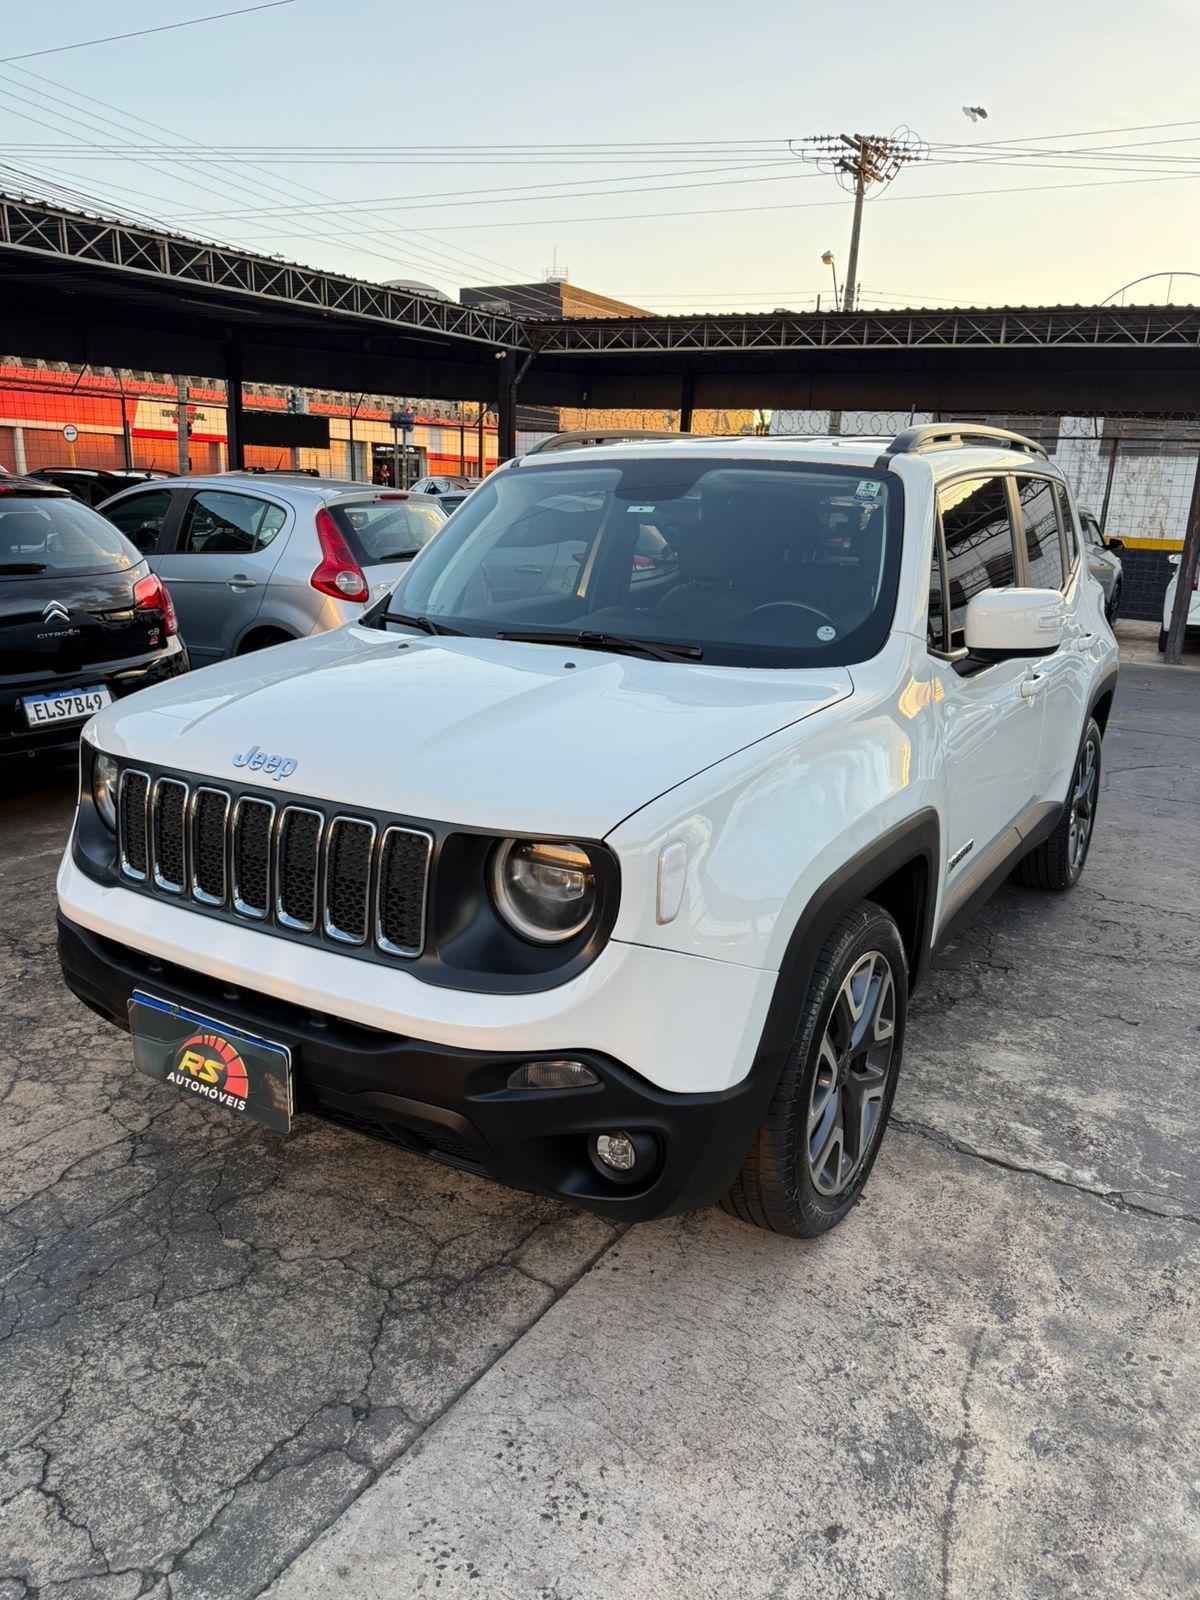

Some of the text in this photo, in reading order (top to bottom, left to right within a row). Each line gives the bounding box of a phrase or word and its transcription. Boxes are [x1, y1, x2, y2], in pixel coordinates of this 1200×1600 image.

[33, 694, 103, 721] ELS7B49
[232, 745, 298, 781] Jeep
[178, 1050, 226, 1084] RS
[166, 1072, 247, 1111] AUTOMÓVEIS
